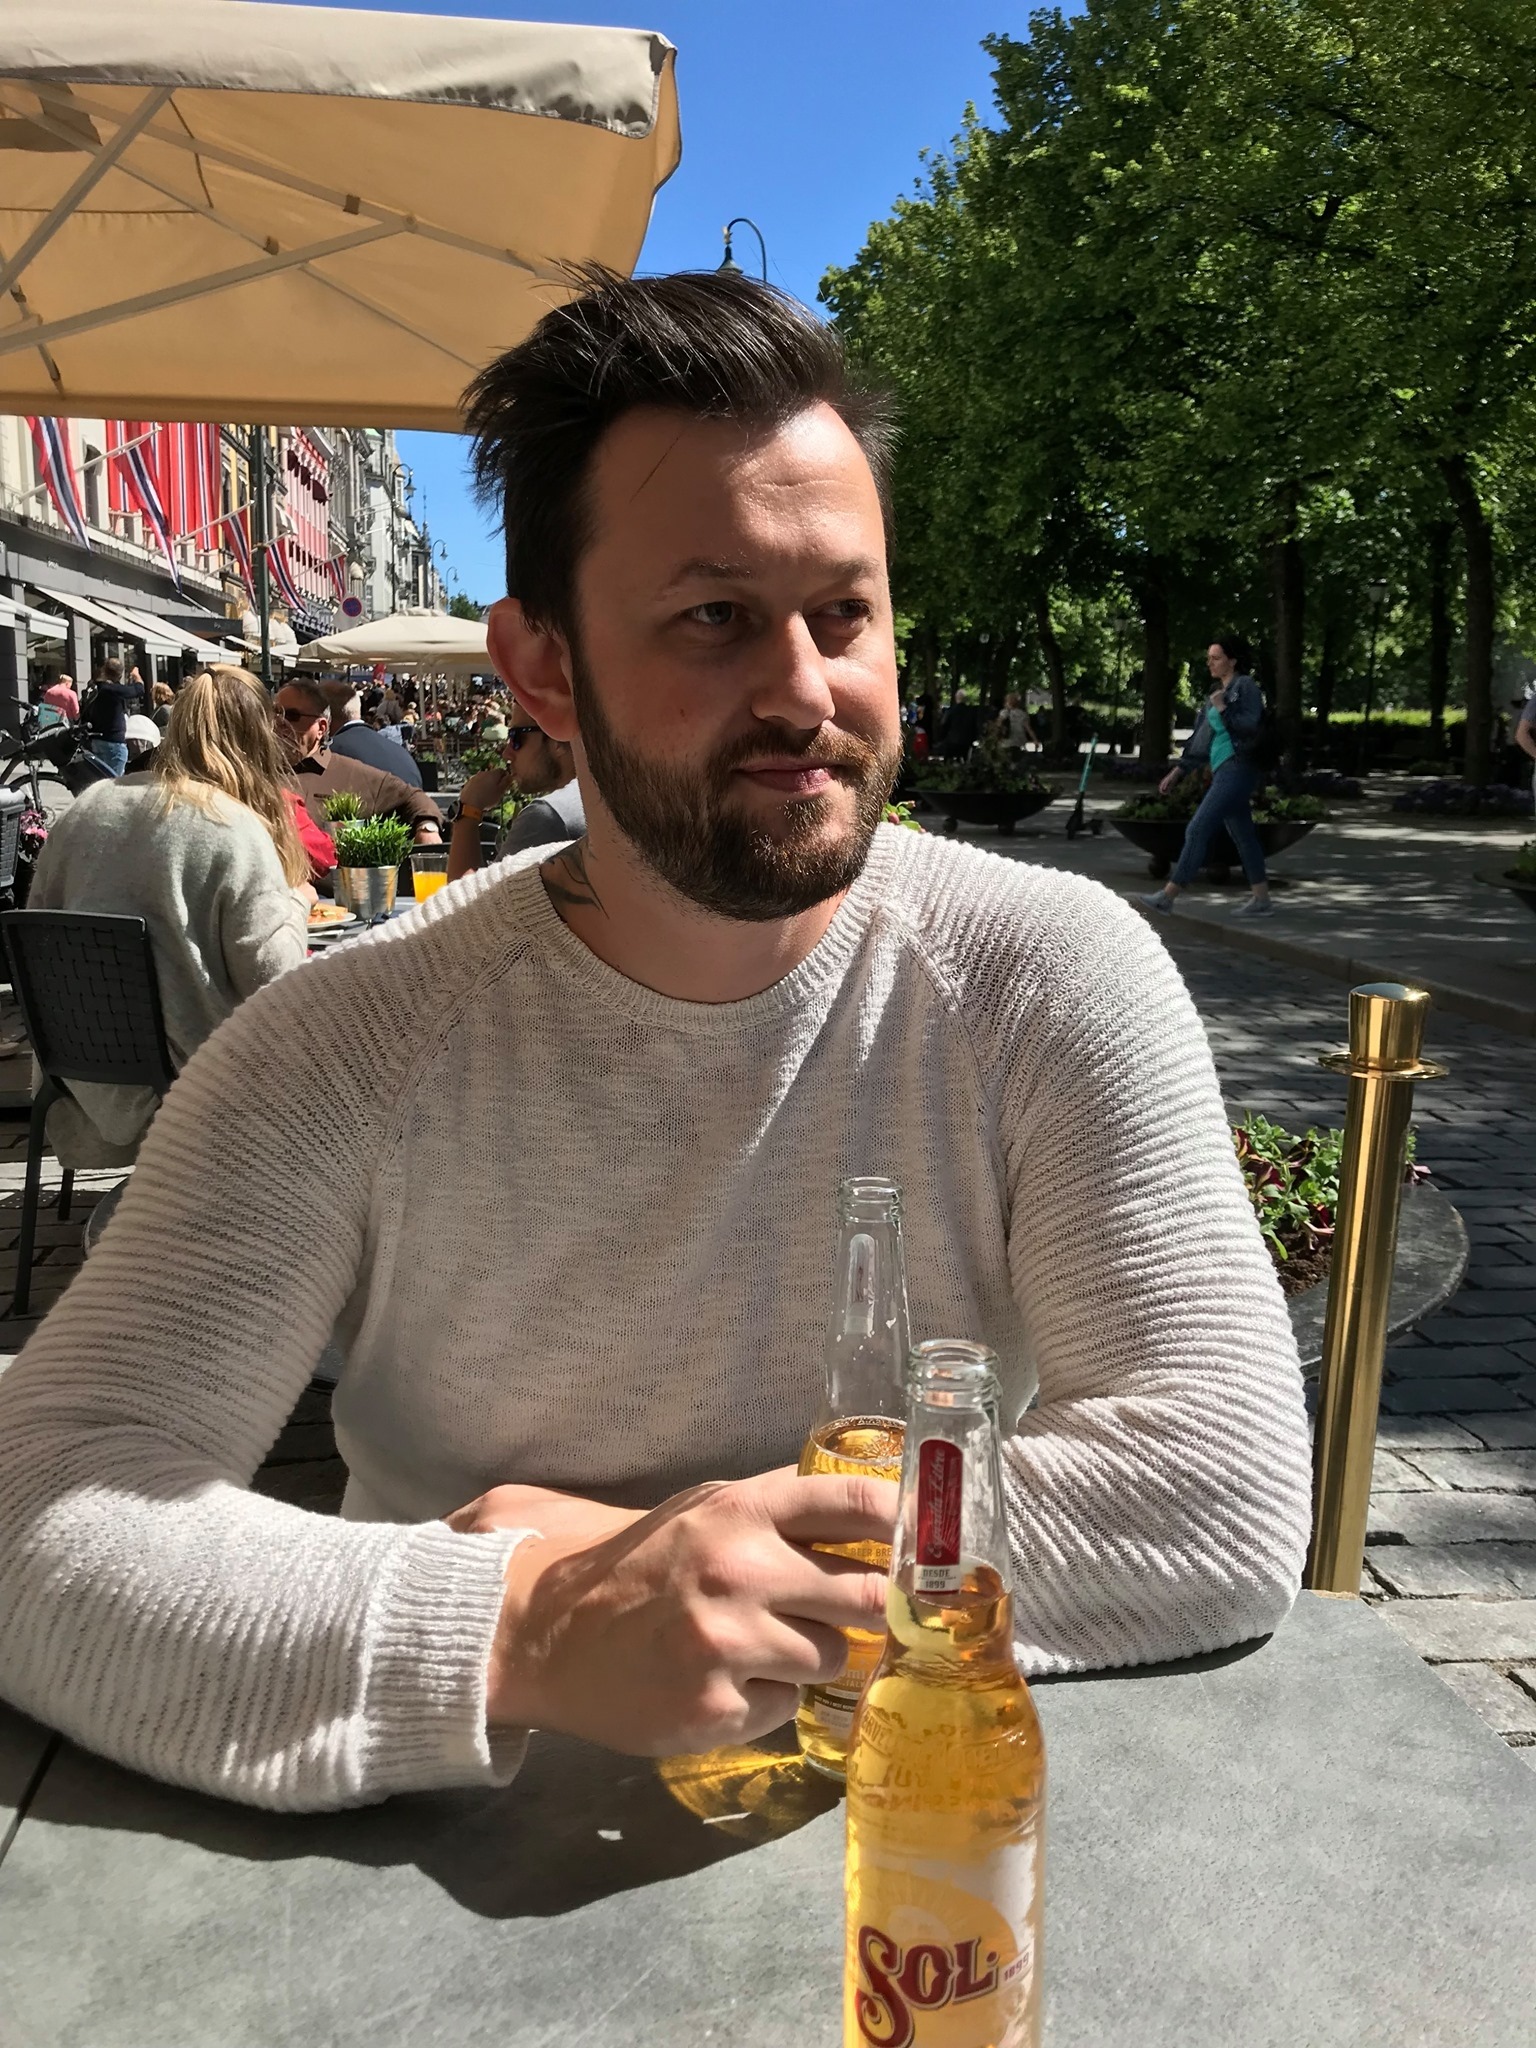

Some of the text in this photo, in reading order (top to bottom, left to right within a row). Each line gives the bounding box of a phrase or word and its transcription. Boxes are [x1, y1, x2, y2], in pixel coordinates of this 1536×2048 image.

[875, 1547, 892, 1558] BRE
[922, 1568, 951, 1578] DESDE
[925, 1580, 946, 1590] 1899
[1003, 1954, 1030, 1981] 1899
